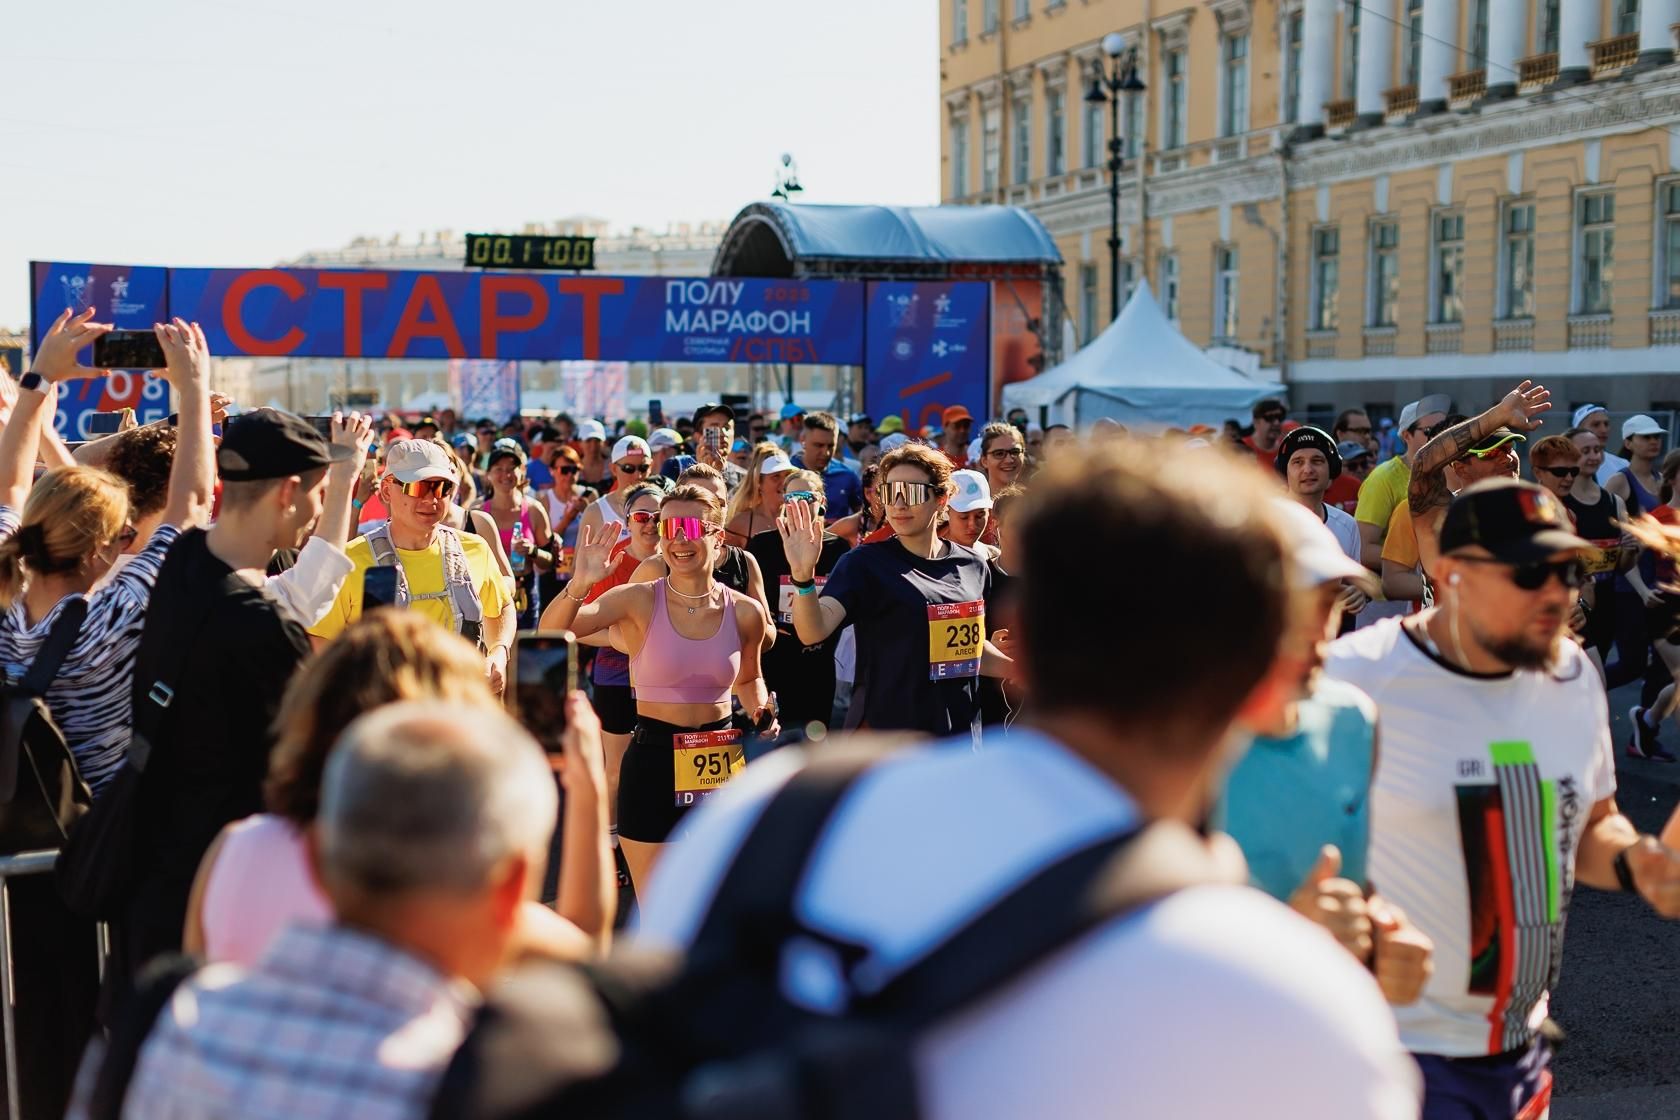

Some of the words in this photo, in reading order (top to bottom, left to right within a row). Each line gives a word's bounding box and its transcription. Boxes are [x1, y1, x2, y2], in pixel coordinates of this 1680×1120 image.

[666, 280, 744, 304] ПОЛУ
[222, 269, 625, 359] СТАРТ
[665, 309, 811, 334] МАРАФОН
[946, 623, 979, 648] 238
[955, 648, 975, 656] АЛЕСЯ
[938, 663, 946, 676] E
[693, 752, 732, 776] 951
[684, 792, 694, 804] D
